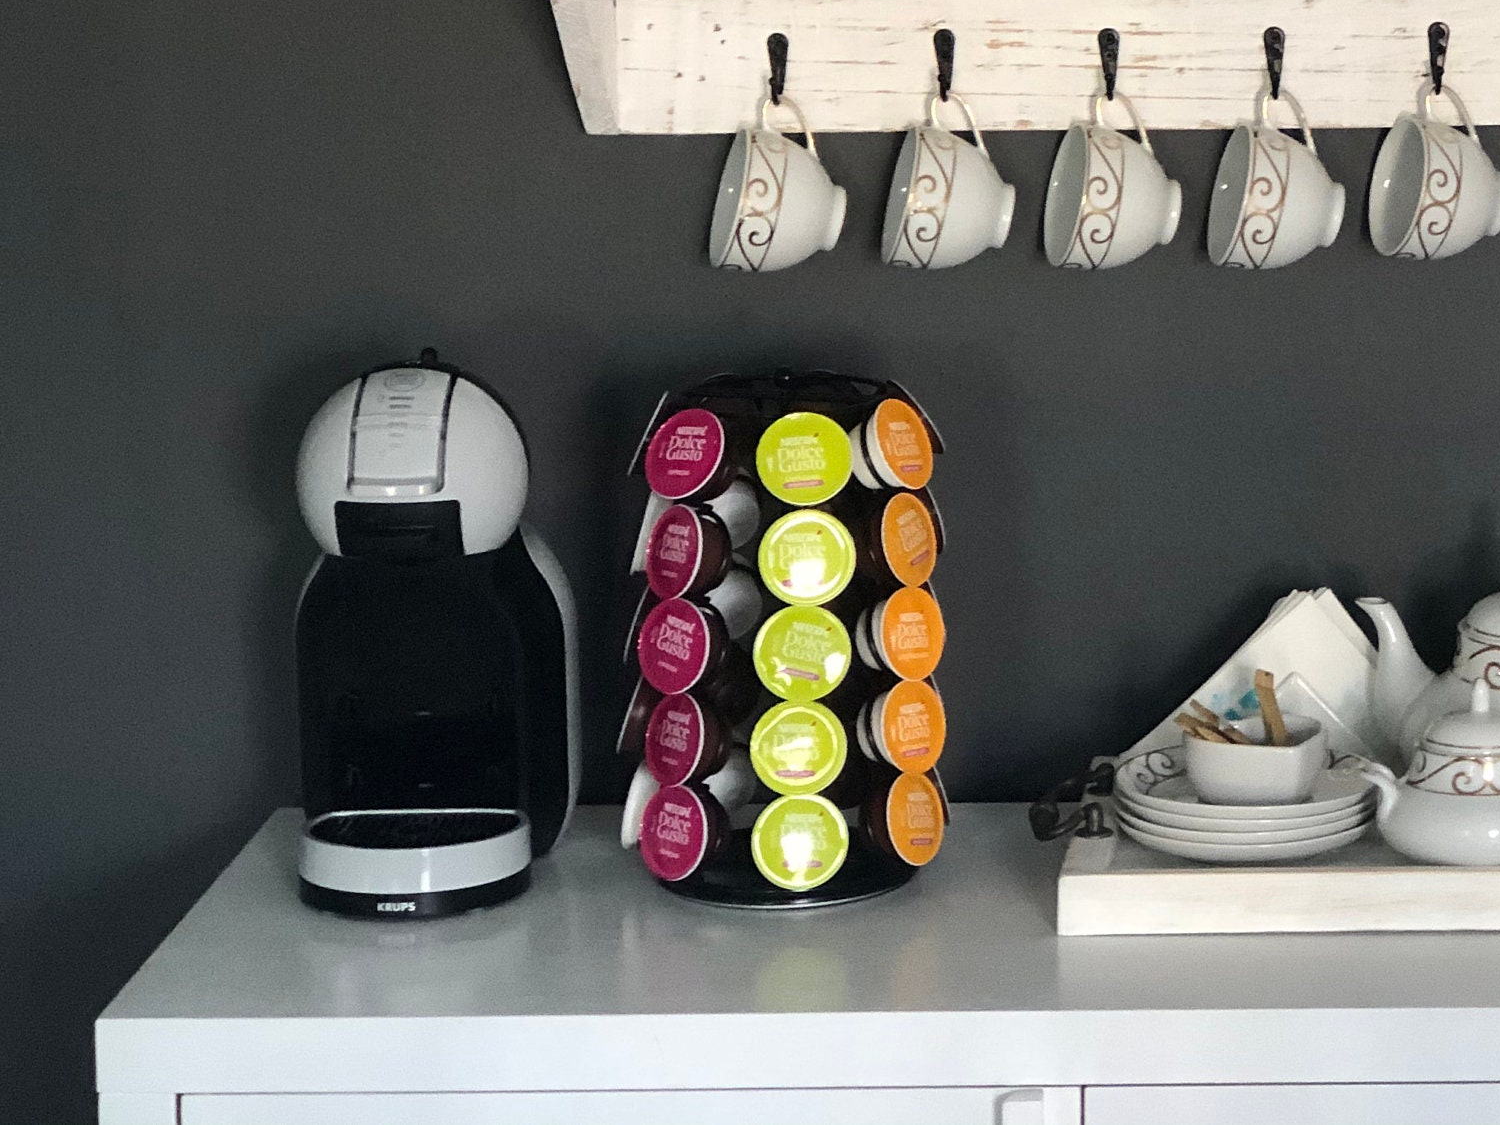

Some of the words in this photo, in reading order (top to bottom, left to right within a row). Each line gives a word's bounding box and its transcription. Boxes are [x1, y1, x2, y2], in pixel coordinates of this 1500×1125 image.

[669, 435, 707, 450] Dolce
[666, 448, 703, 462] Gusto
[777, 445, 824, 460] Dolce
[779, 459, 827, 473] Gusto
[660, 623, 693, 649] Dolce
[656, 637, 690, 661] Gusto
[377, 902, 416, 912] KRUPS
